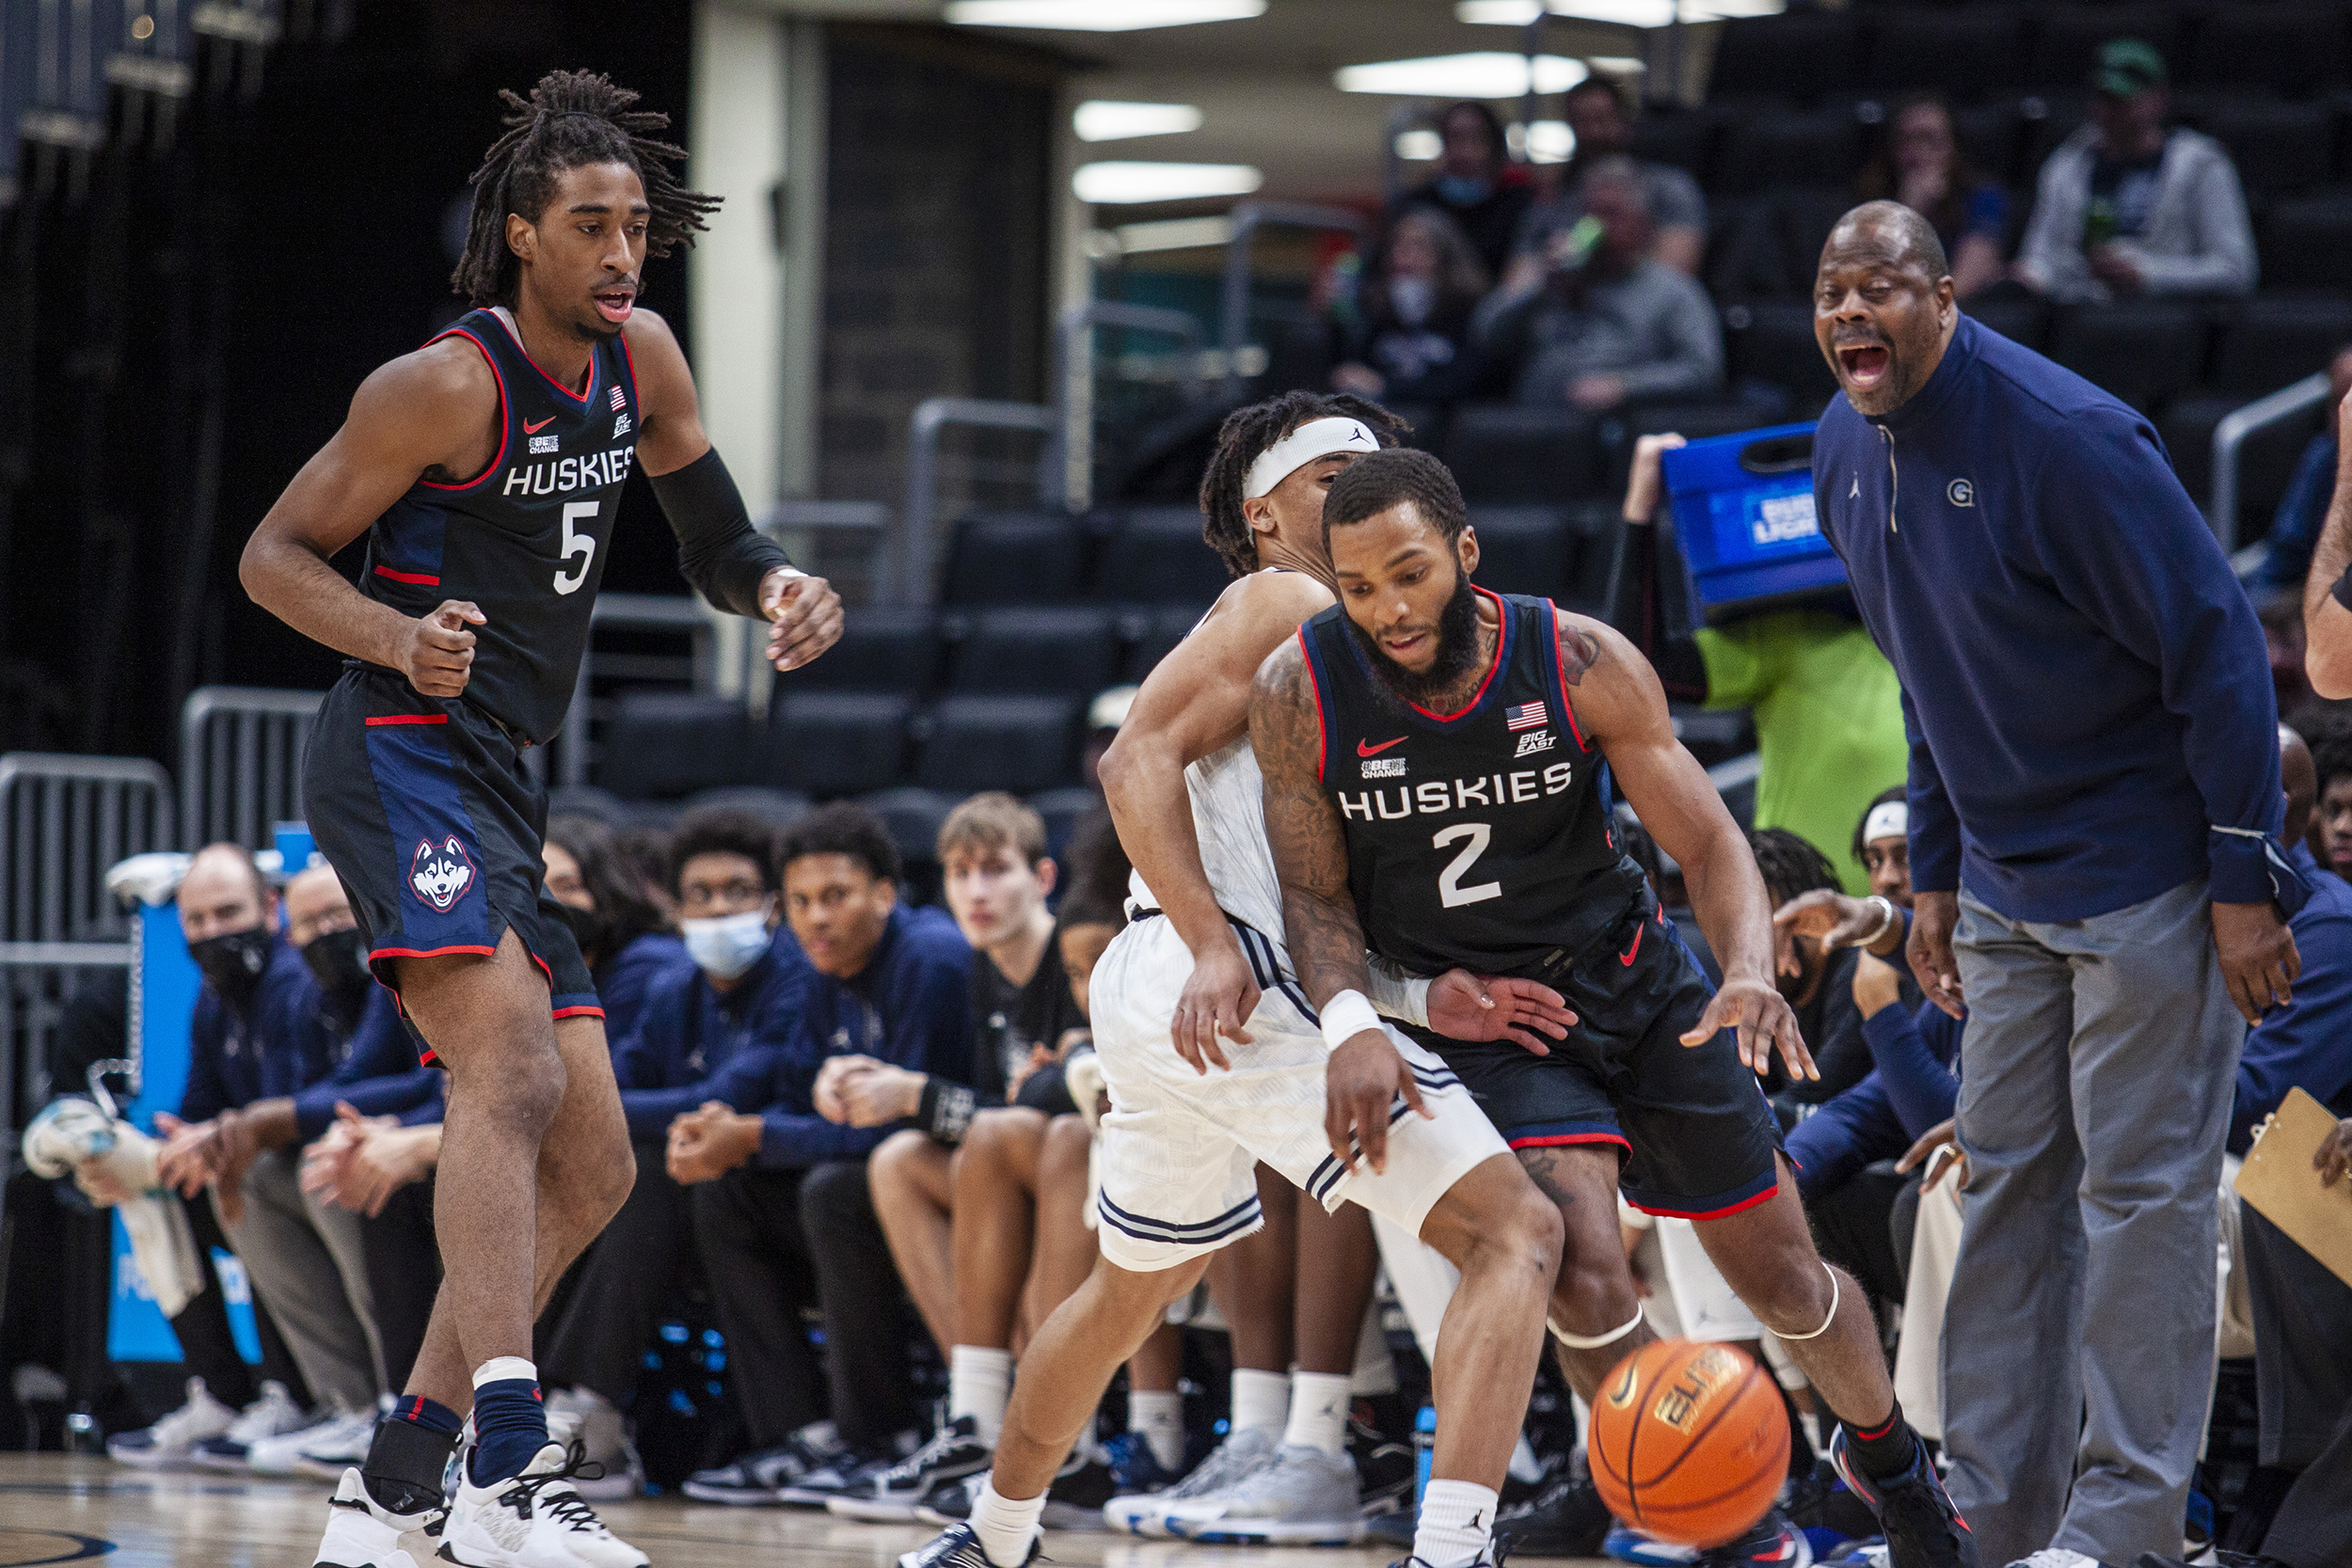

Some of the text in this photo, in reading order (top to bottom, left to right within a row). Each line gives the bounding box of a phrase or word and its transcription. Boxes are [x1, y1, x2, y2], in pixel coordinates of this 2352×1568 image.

[530, 445, 559, 454] CHANGE
[1753, 516, 1818, 544] LIGH
[553, 501, 600, 595] 5
[1517, 736, 1557, 753] EAST
[1519, 730, 1548, 744] BIG
[1361, 768, 1406, 779] CHANGE
[1339, 762, 1571, 821] HUSKIES
[1433, 823, 1502, 909] 2
